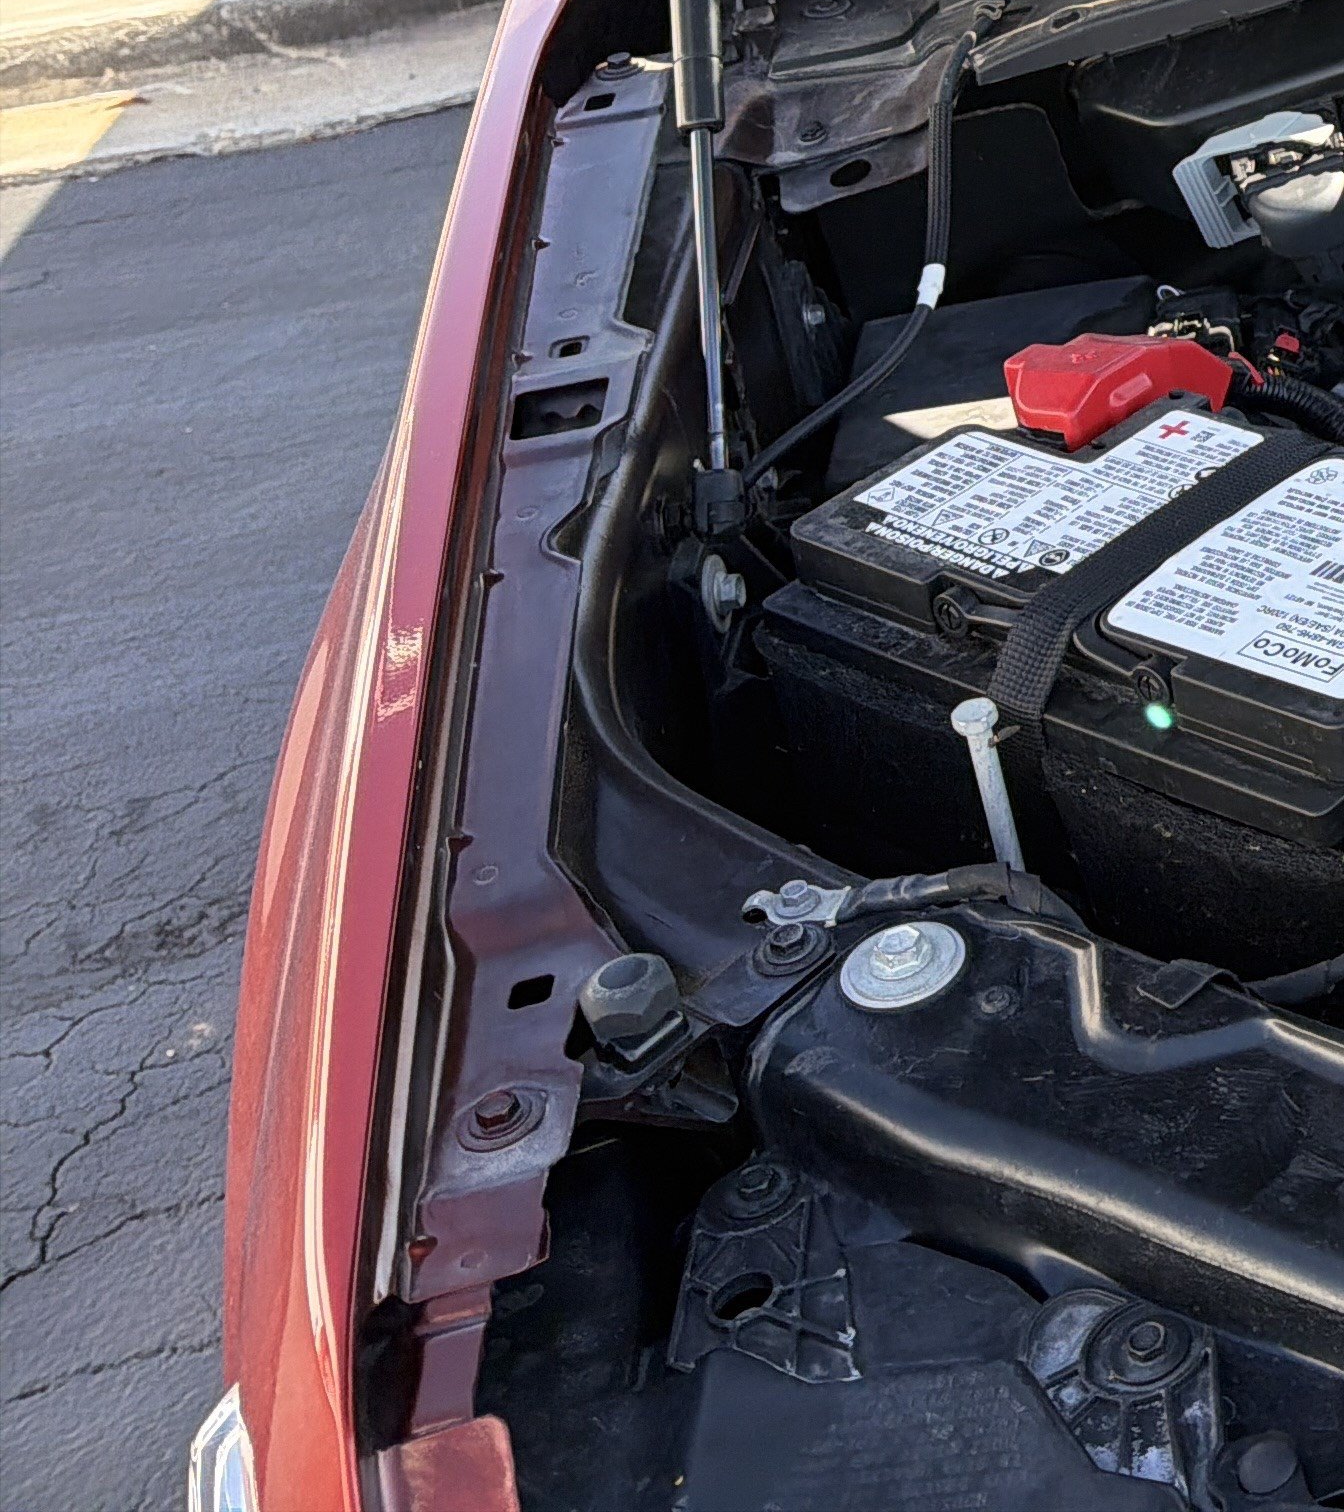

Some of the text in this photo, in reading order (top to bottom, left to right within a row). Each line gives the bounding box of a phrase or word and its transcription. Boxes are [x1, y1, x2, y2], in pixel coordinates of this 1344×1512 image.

[872, 525, 996, 575] DANGER/POISON
[889, 516, 1022, 570] PELIGRO/VENENO
[1254, 603, 1291, 620] 120RC
